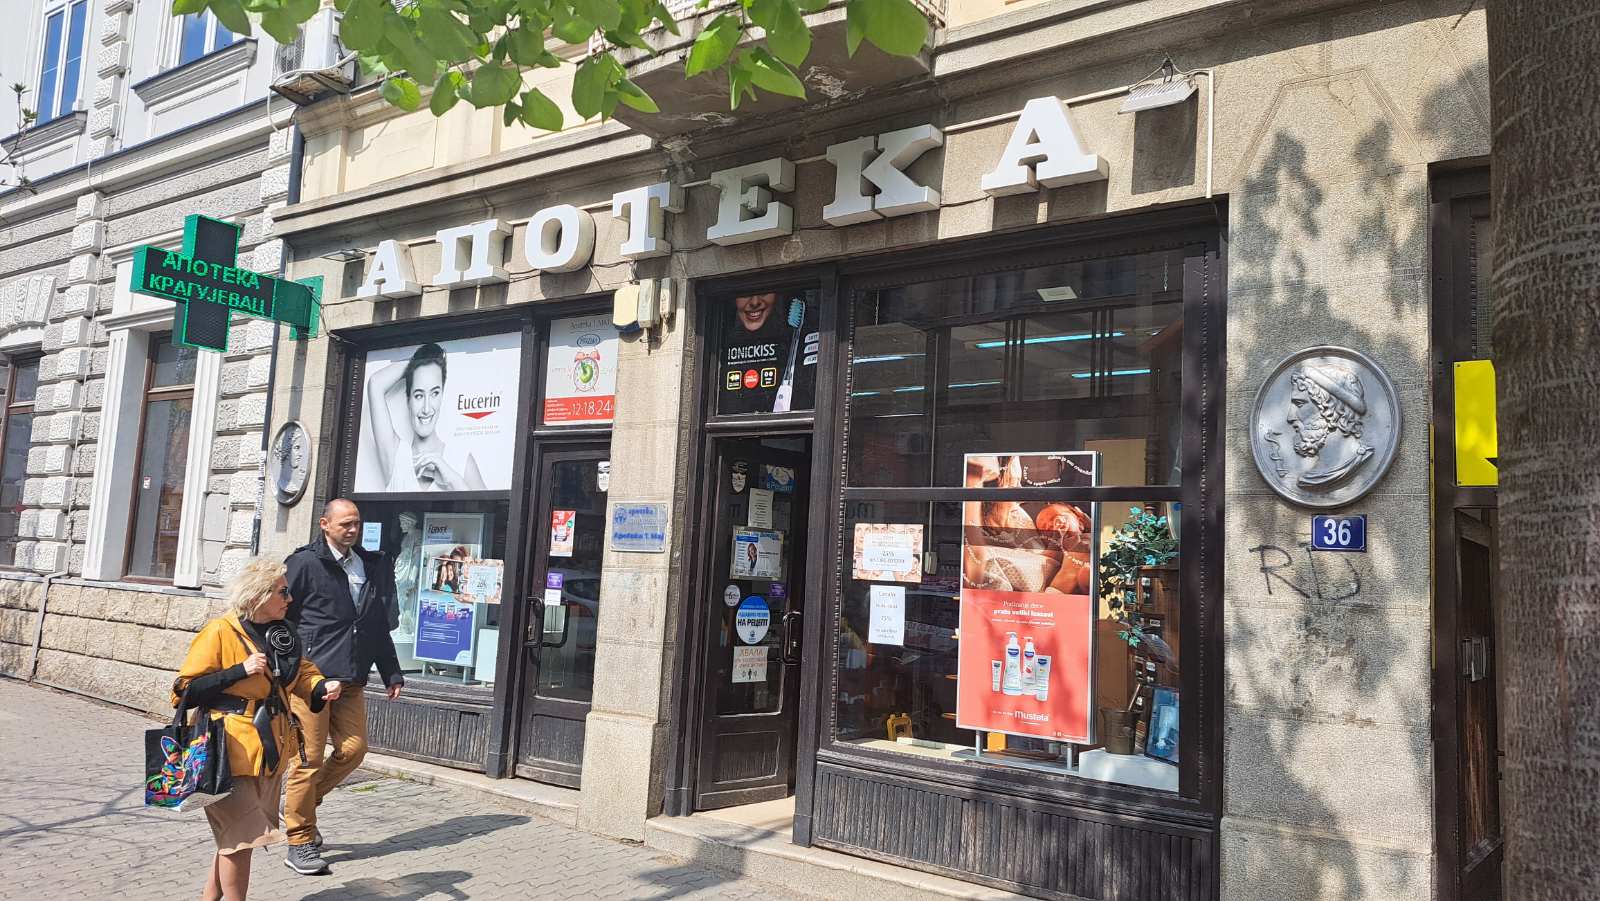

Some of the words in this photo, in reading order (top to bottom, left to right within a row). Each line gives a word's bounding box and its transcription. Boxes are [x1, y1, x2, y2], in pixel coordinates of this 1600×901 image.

[356, 95, 1109, 299] АПОТЕКА
[162, 251, 261, 290] АПОТЕКА
[150, 272, 266, 316] КРАГУЈЕВАЦ
[457, 392, 501, 410] Eucerin
[1322, 518, 1351, 546] 36
